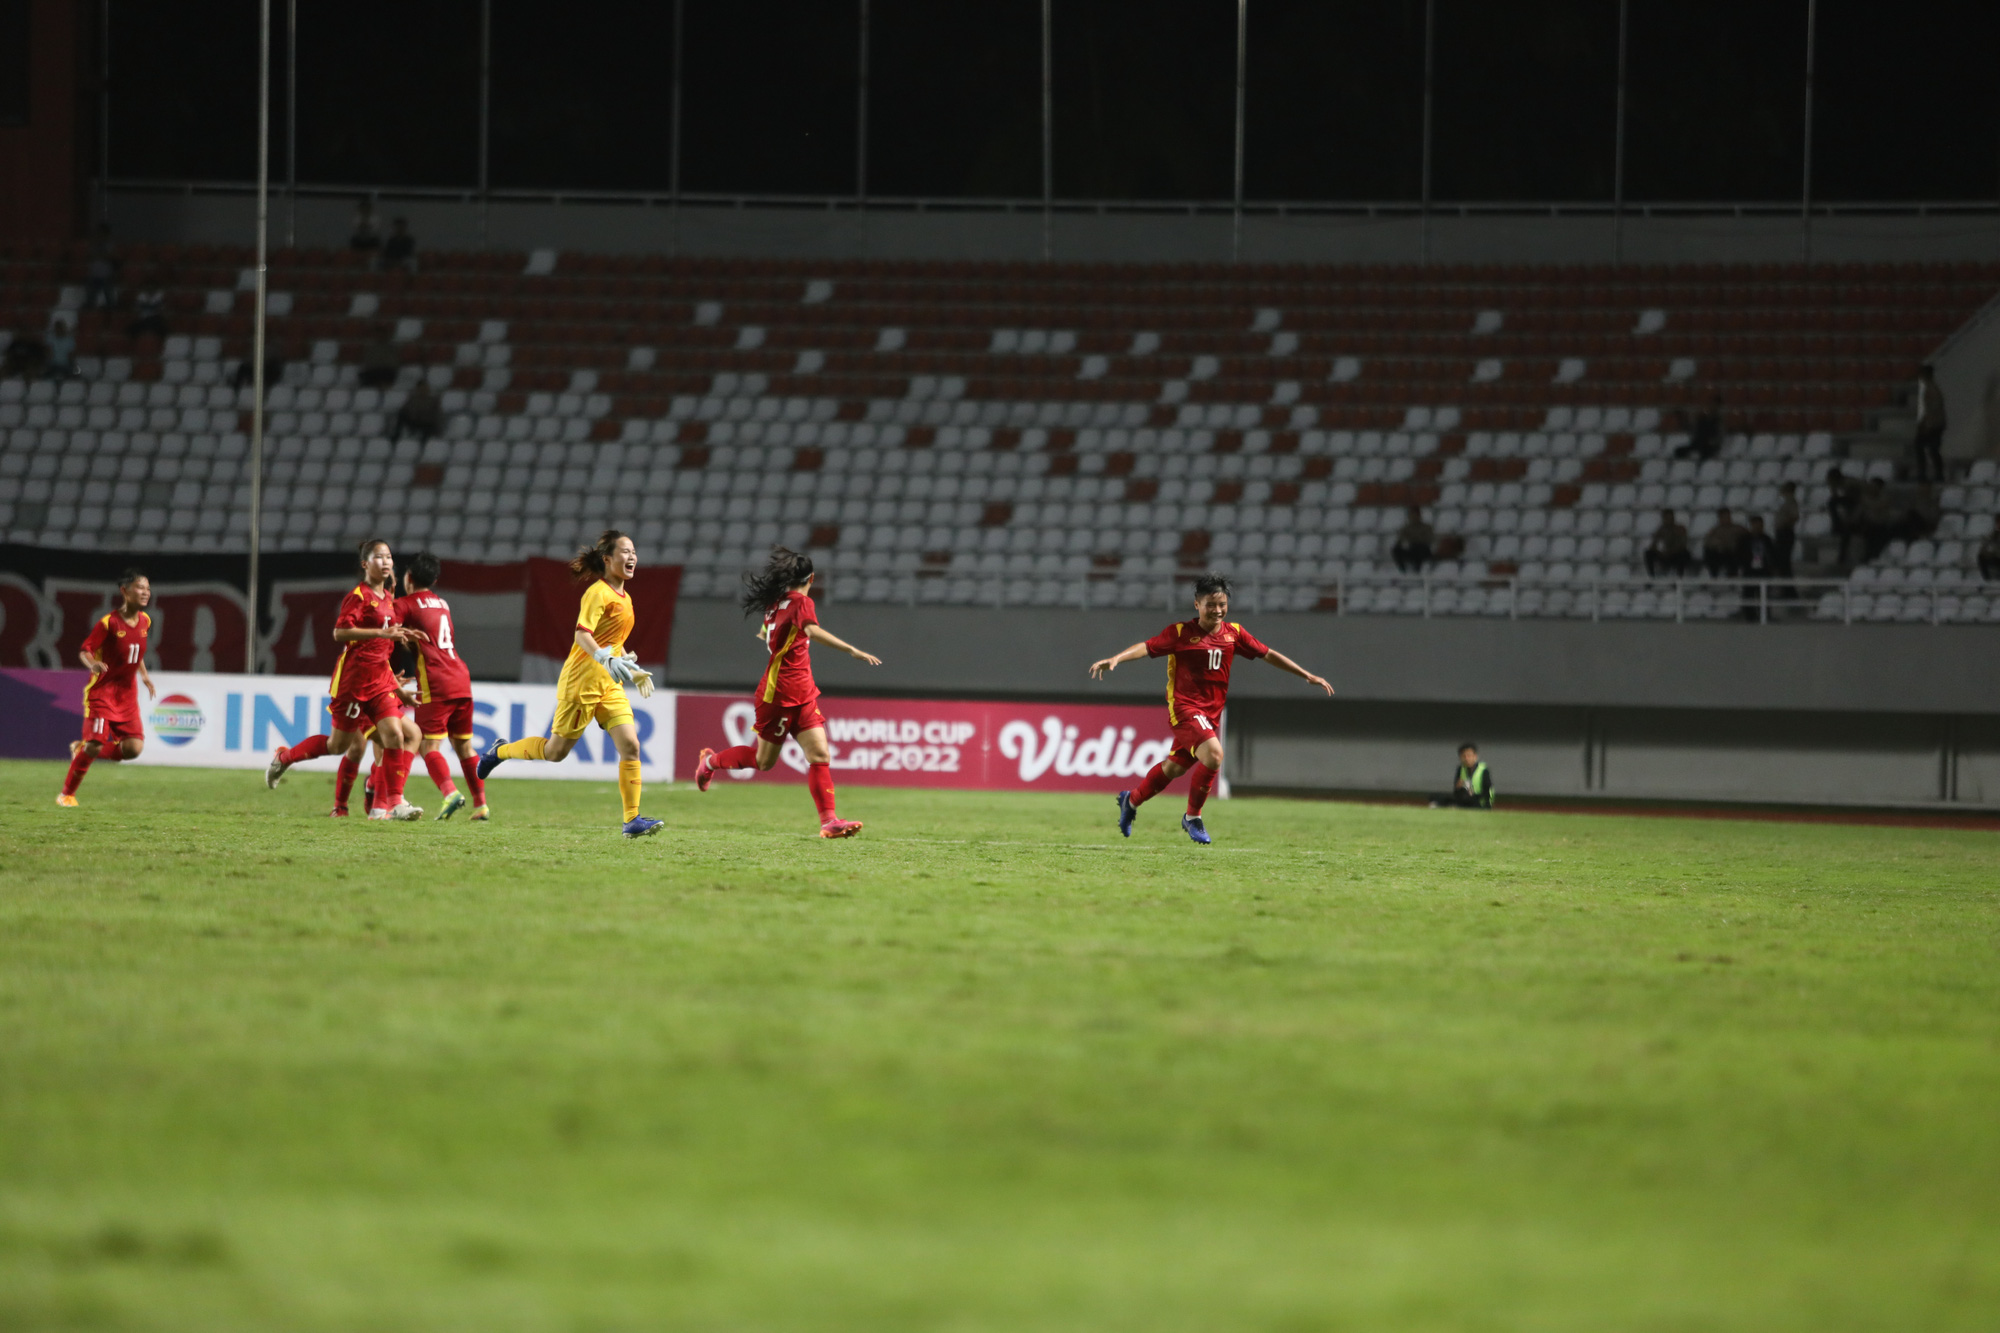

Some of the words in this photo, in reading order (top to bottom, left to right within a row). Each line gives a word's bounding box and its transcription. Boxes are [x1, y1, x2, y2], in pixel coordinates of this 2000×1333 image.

[438, 613, 456, 660] 4
[128, 643, 140, 664] 11
[1207, 648, 1223, 671] 10
[93, 717, 105, 735] 11
[774, 716, 789, 737] 5
[828, 718, 921, 743] WORLD
[922, 720, 976, 745] CUP
